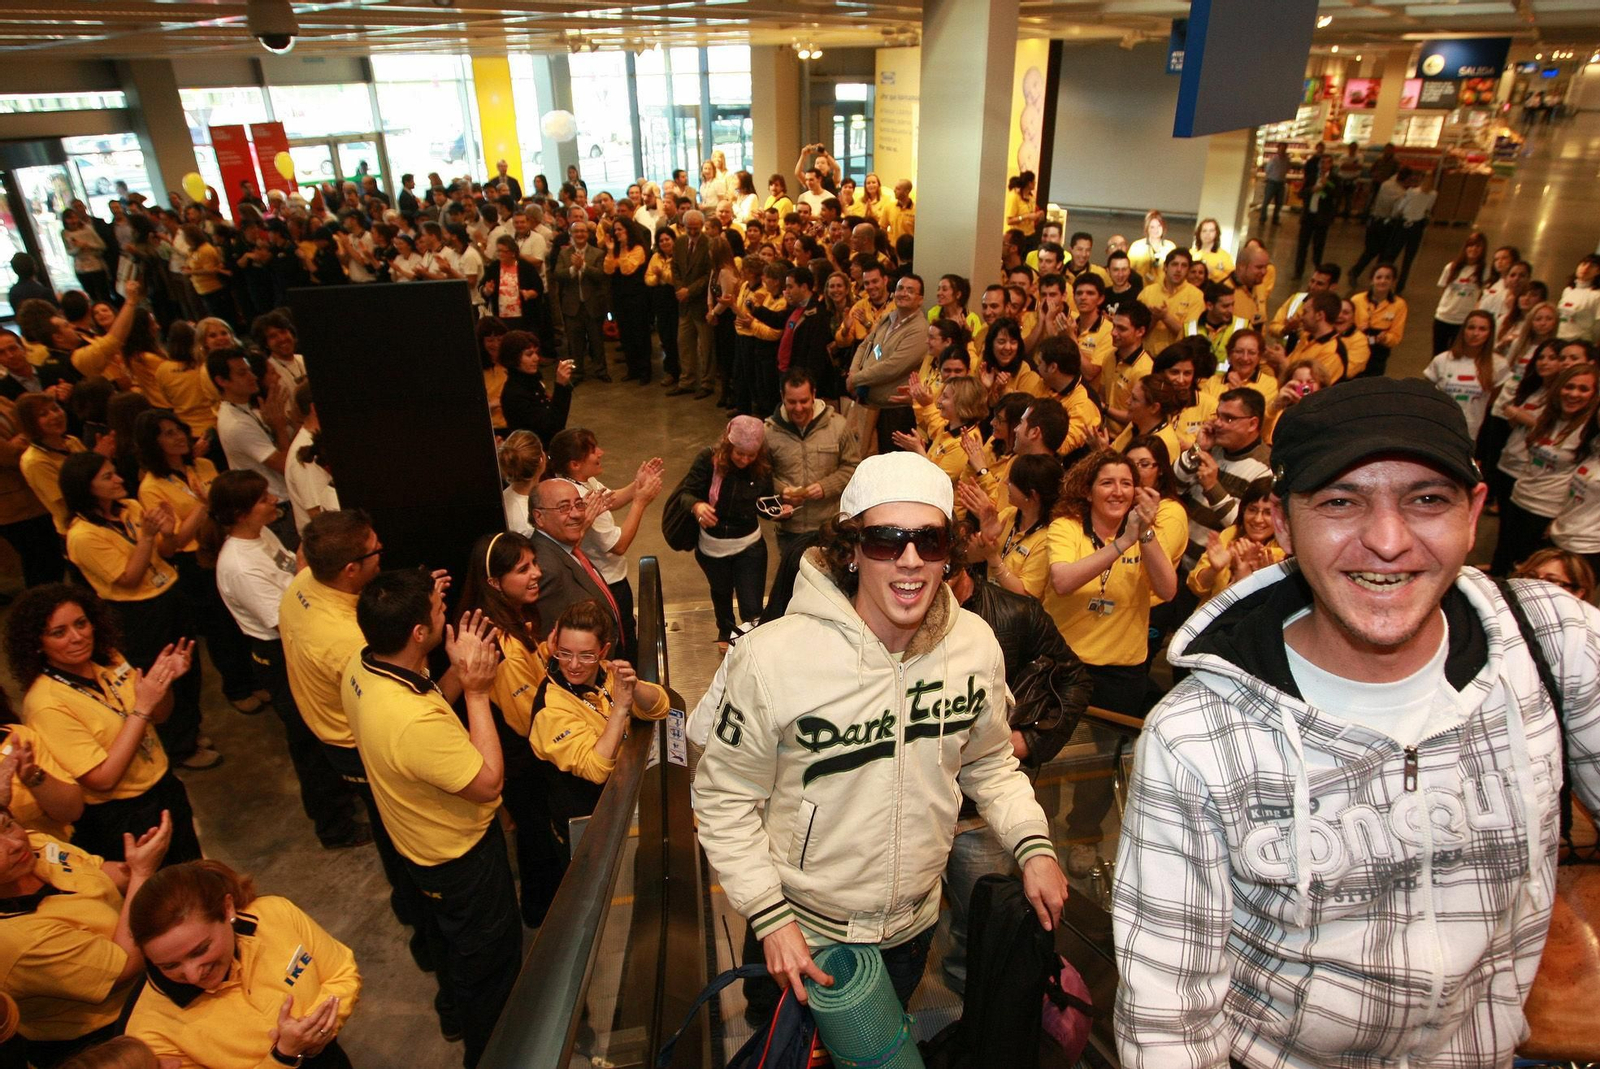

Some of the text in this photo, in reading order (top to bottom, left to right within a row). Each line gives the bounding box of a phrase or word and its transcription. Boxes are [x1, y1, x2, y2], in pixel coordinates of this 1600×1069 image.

[512, 684, 530, 698] IKEA
[553, 728, 571, 744] IKEA
[796, 709, 897, 753] Dark
[1251, 808, 1282, 819] King
